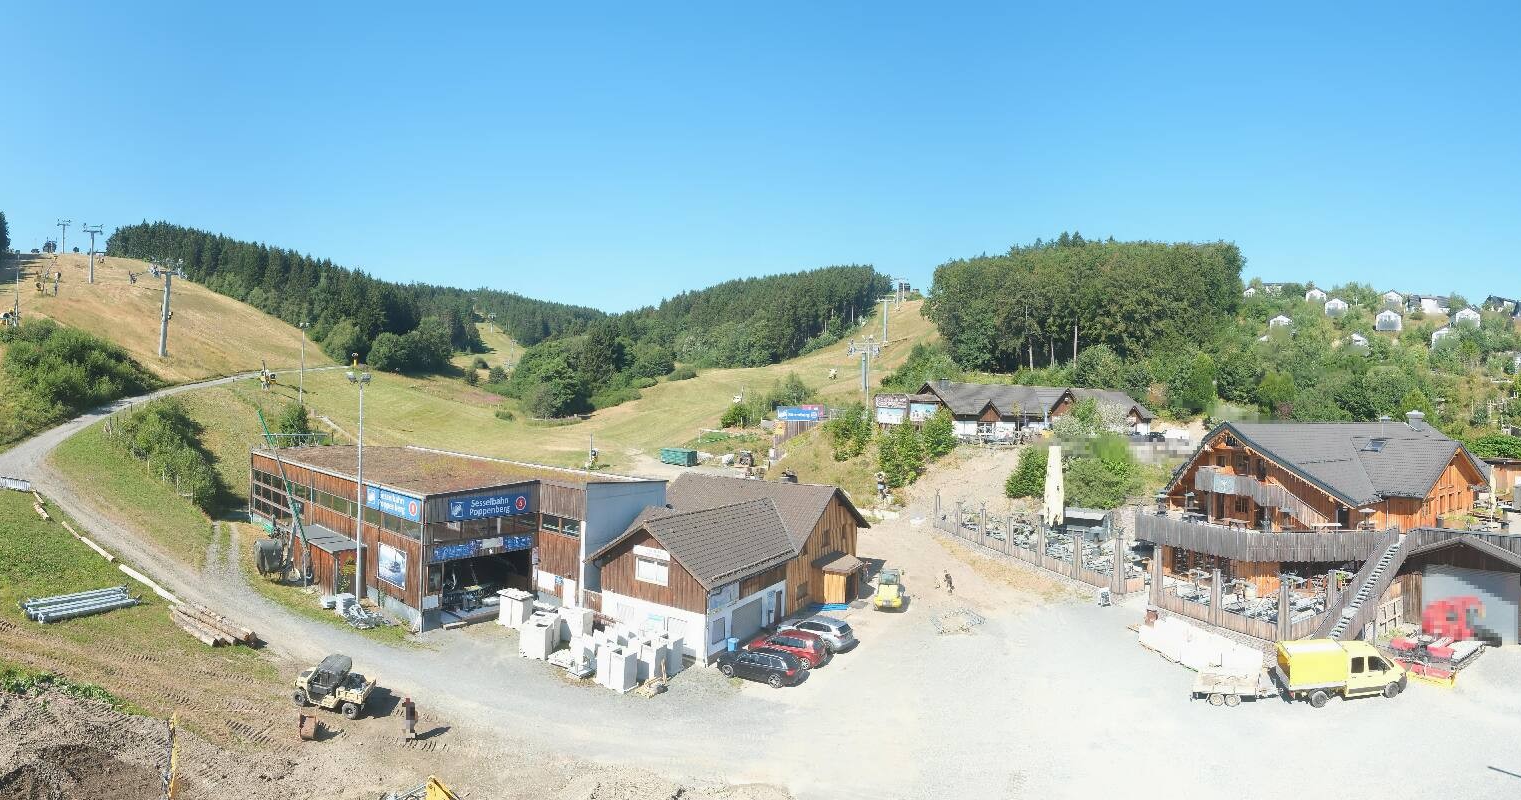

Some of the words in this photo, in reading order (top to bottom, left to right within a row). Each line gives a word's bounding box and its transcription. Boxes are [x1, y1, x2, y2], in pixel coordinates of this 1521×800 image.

[380, 490, 405, 505] essebahn
[471, 496, 509, 508] Sesselbahn
[469, 505, 511, 517] Poppenberg
